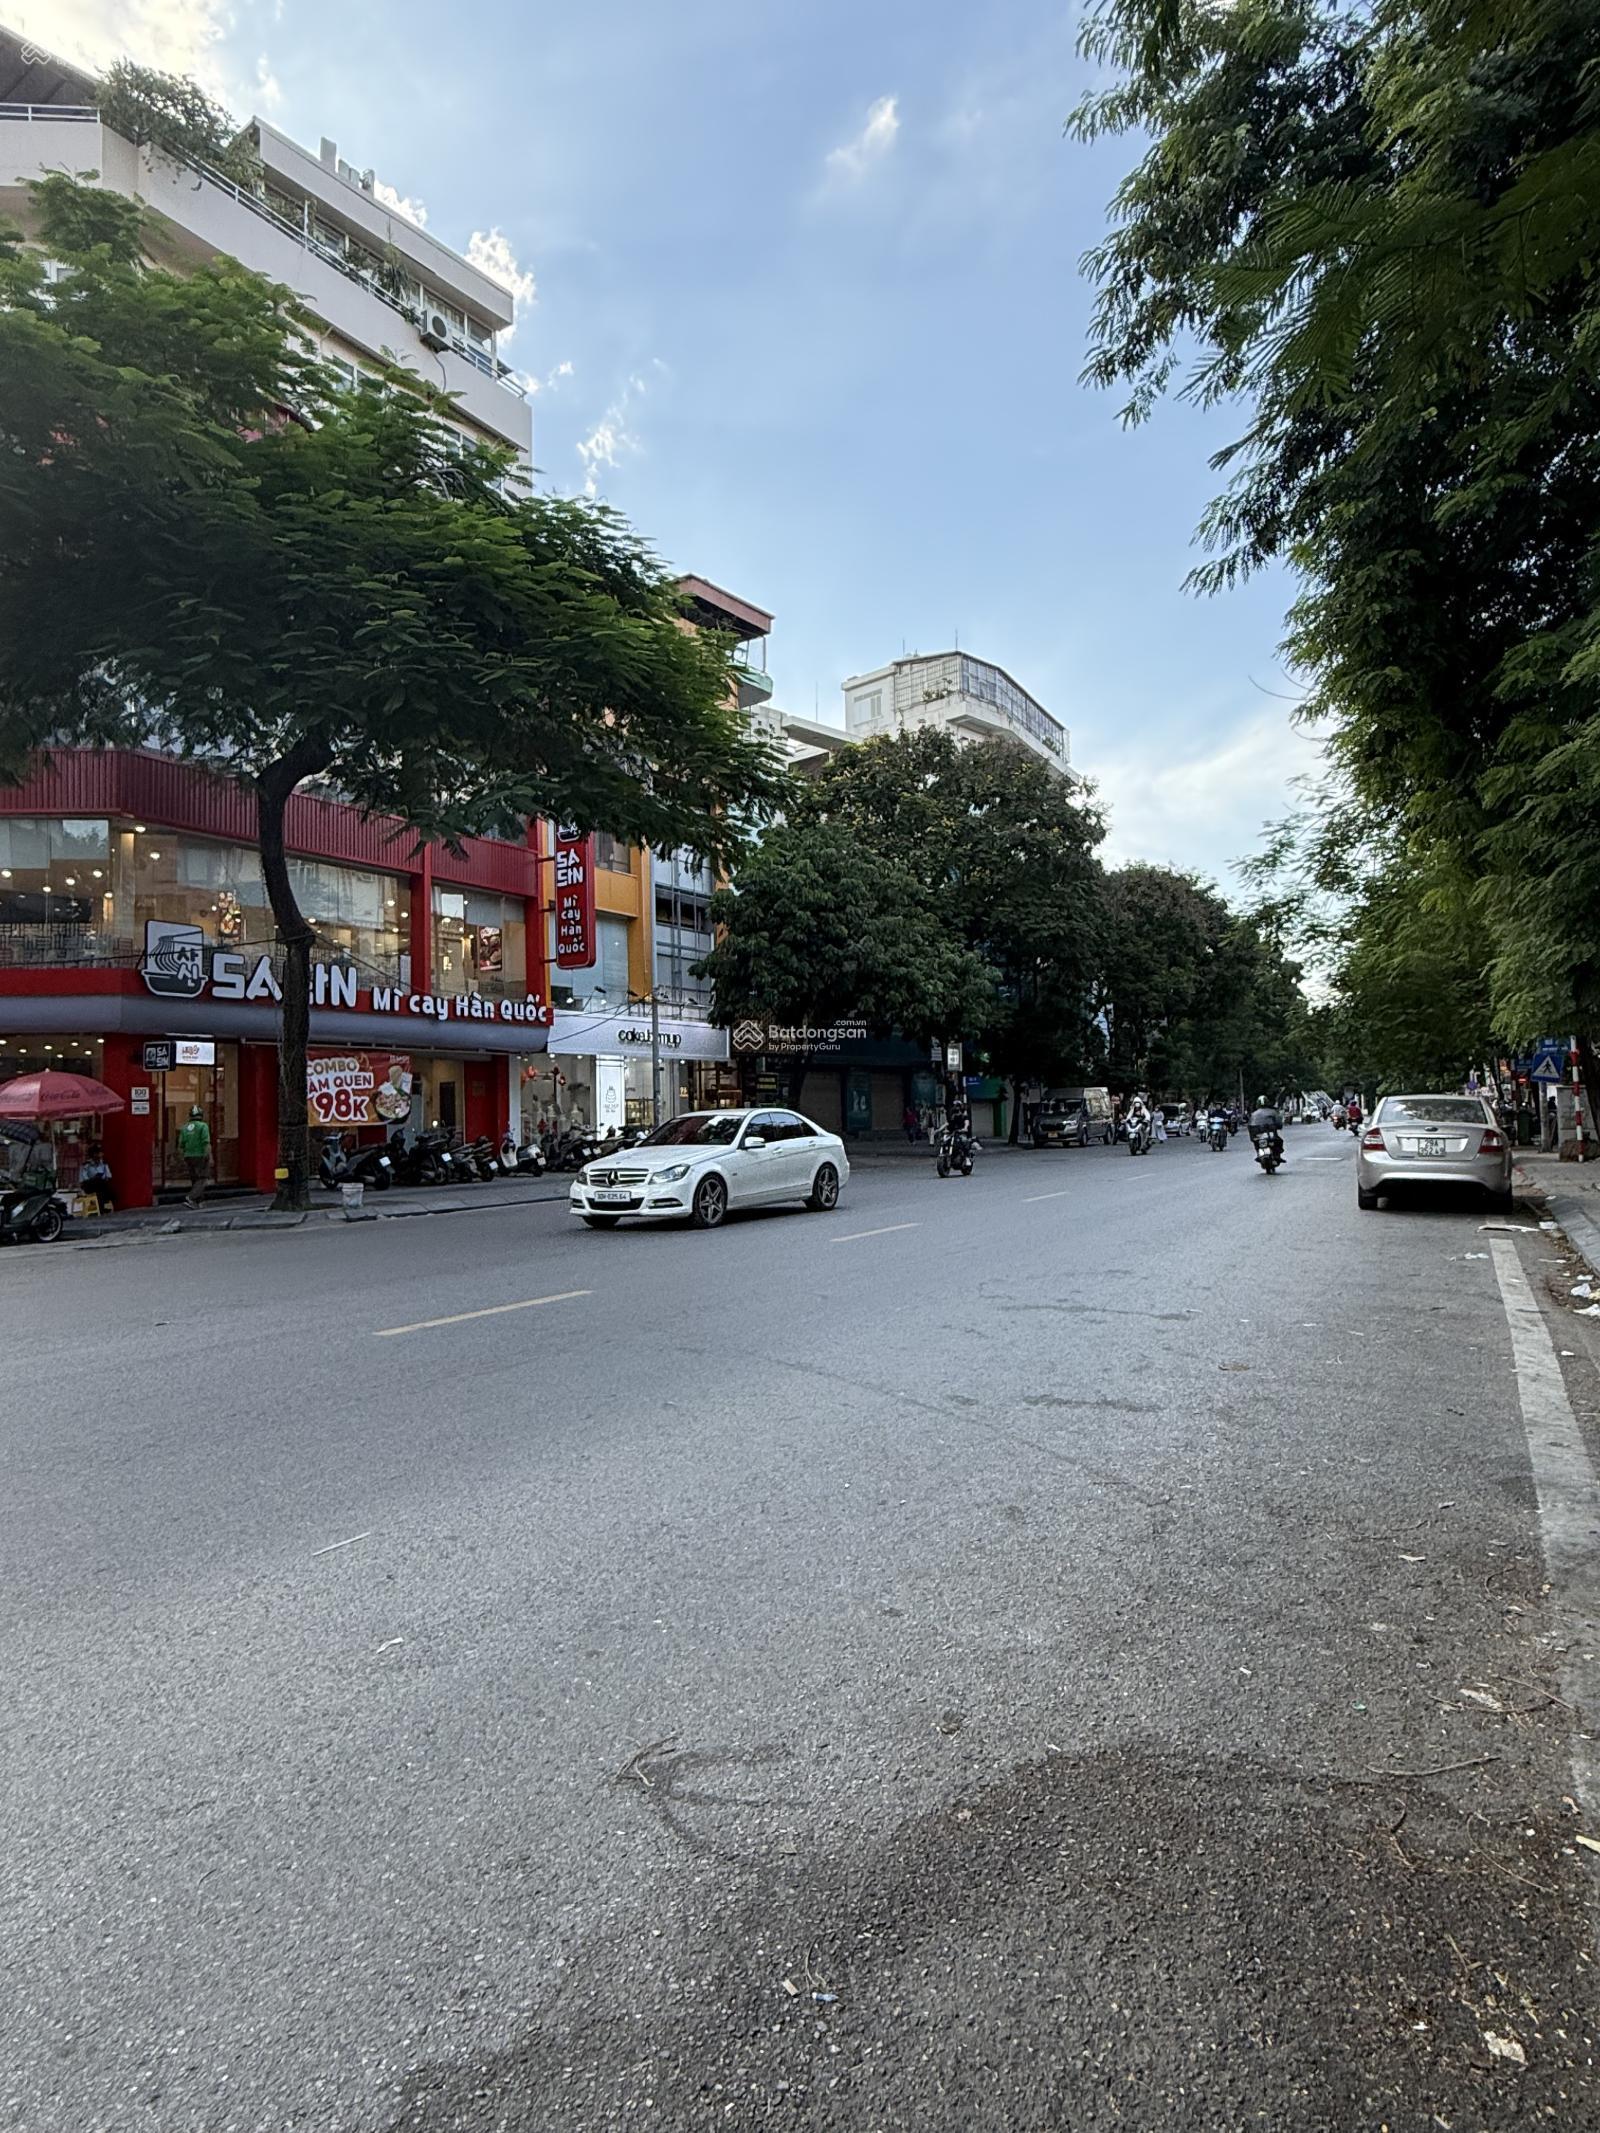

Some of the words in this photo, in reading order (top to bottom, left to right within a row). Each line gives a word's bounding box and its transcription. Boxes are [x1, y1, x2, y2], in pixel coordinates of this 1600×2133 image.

[561, 909, 581, 920] cay
[561, 921, 582, 936] Hàn
[558, 937, 585, 954] Quốc
[372, 986, 404, 1012] Mì
[409, 994, 449, 1021] cay
[455, 992, 495, 1019] Hàn
[500, 993, 548, 1022] Quốc
[334, 1074, 372, 1088] QUEN
